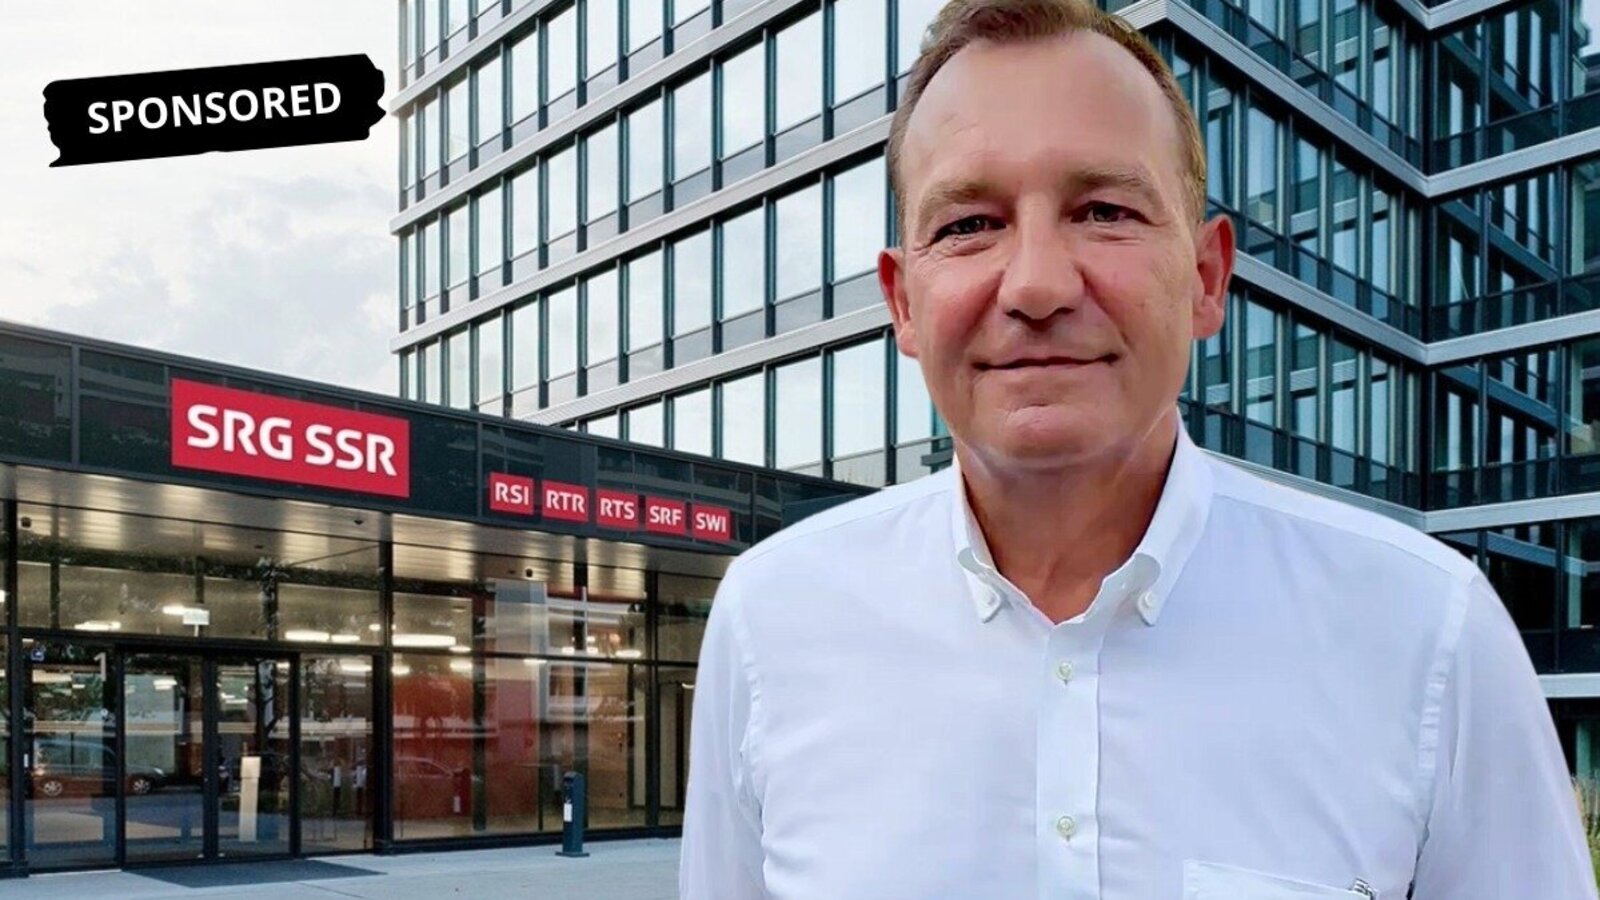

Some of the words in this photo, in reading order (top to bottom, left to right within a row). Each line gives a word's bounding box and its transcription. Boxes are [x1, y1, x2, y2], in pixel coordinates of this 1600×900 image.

[187, 404, 293, 461] SRG
[305, 424, 397, 476] SSR
[494, 482, 530, 506] RSI
[546, 491, 586, 514] RTR
[600, 498, 636, 520] RTS
[649, 505, 683, 526] SRF
[695, 511, 727, 533] SWI
